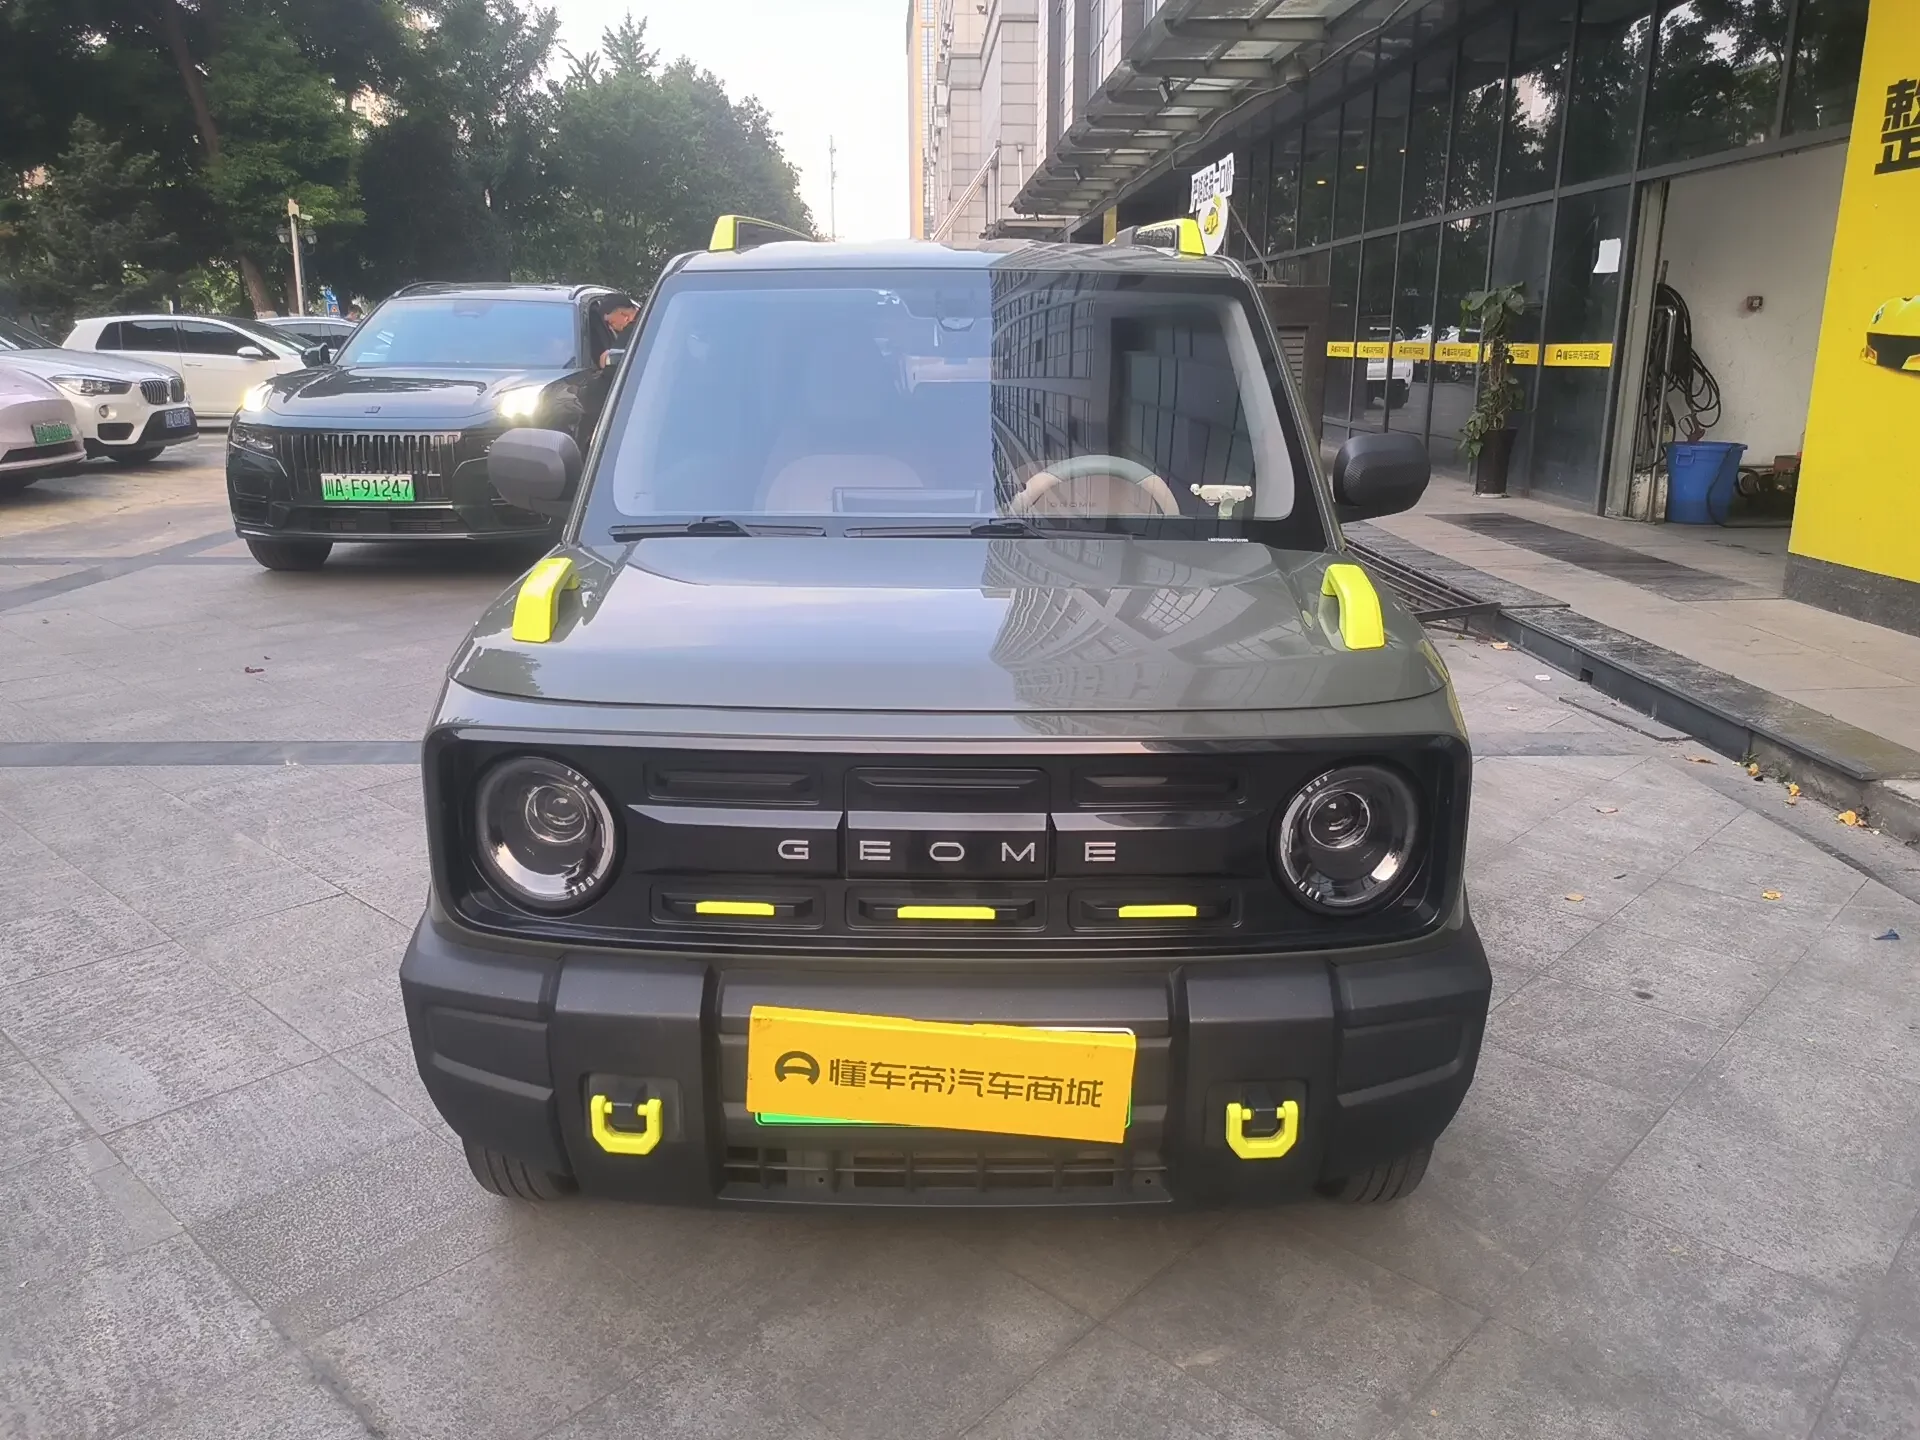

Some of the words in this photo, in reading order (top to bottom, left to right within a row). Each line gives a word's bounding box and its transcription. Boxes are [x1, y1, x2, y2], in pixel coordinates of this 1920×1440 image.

[829, 1058, 1104, 1108] 懂车帝汽车商城
